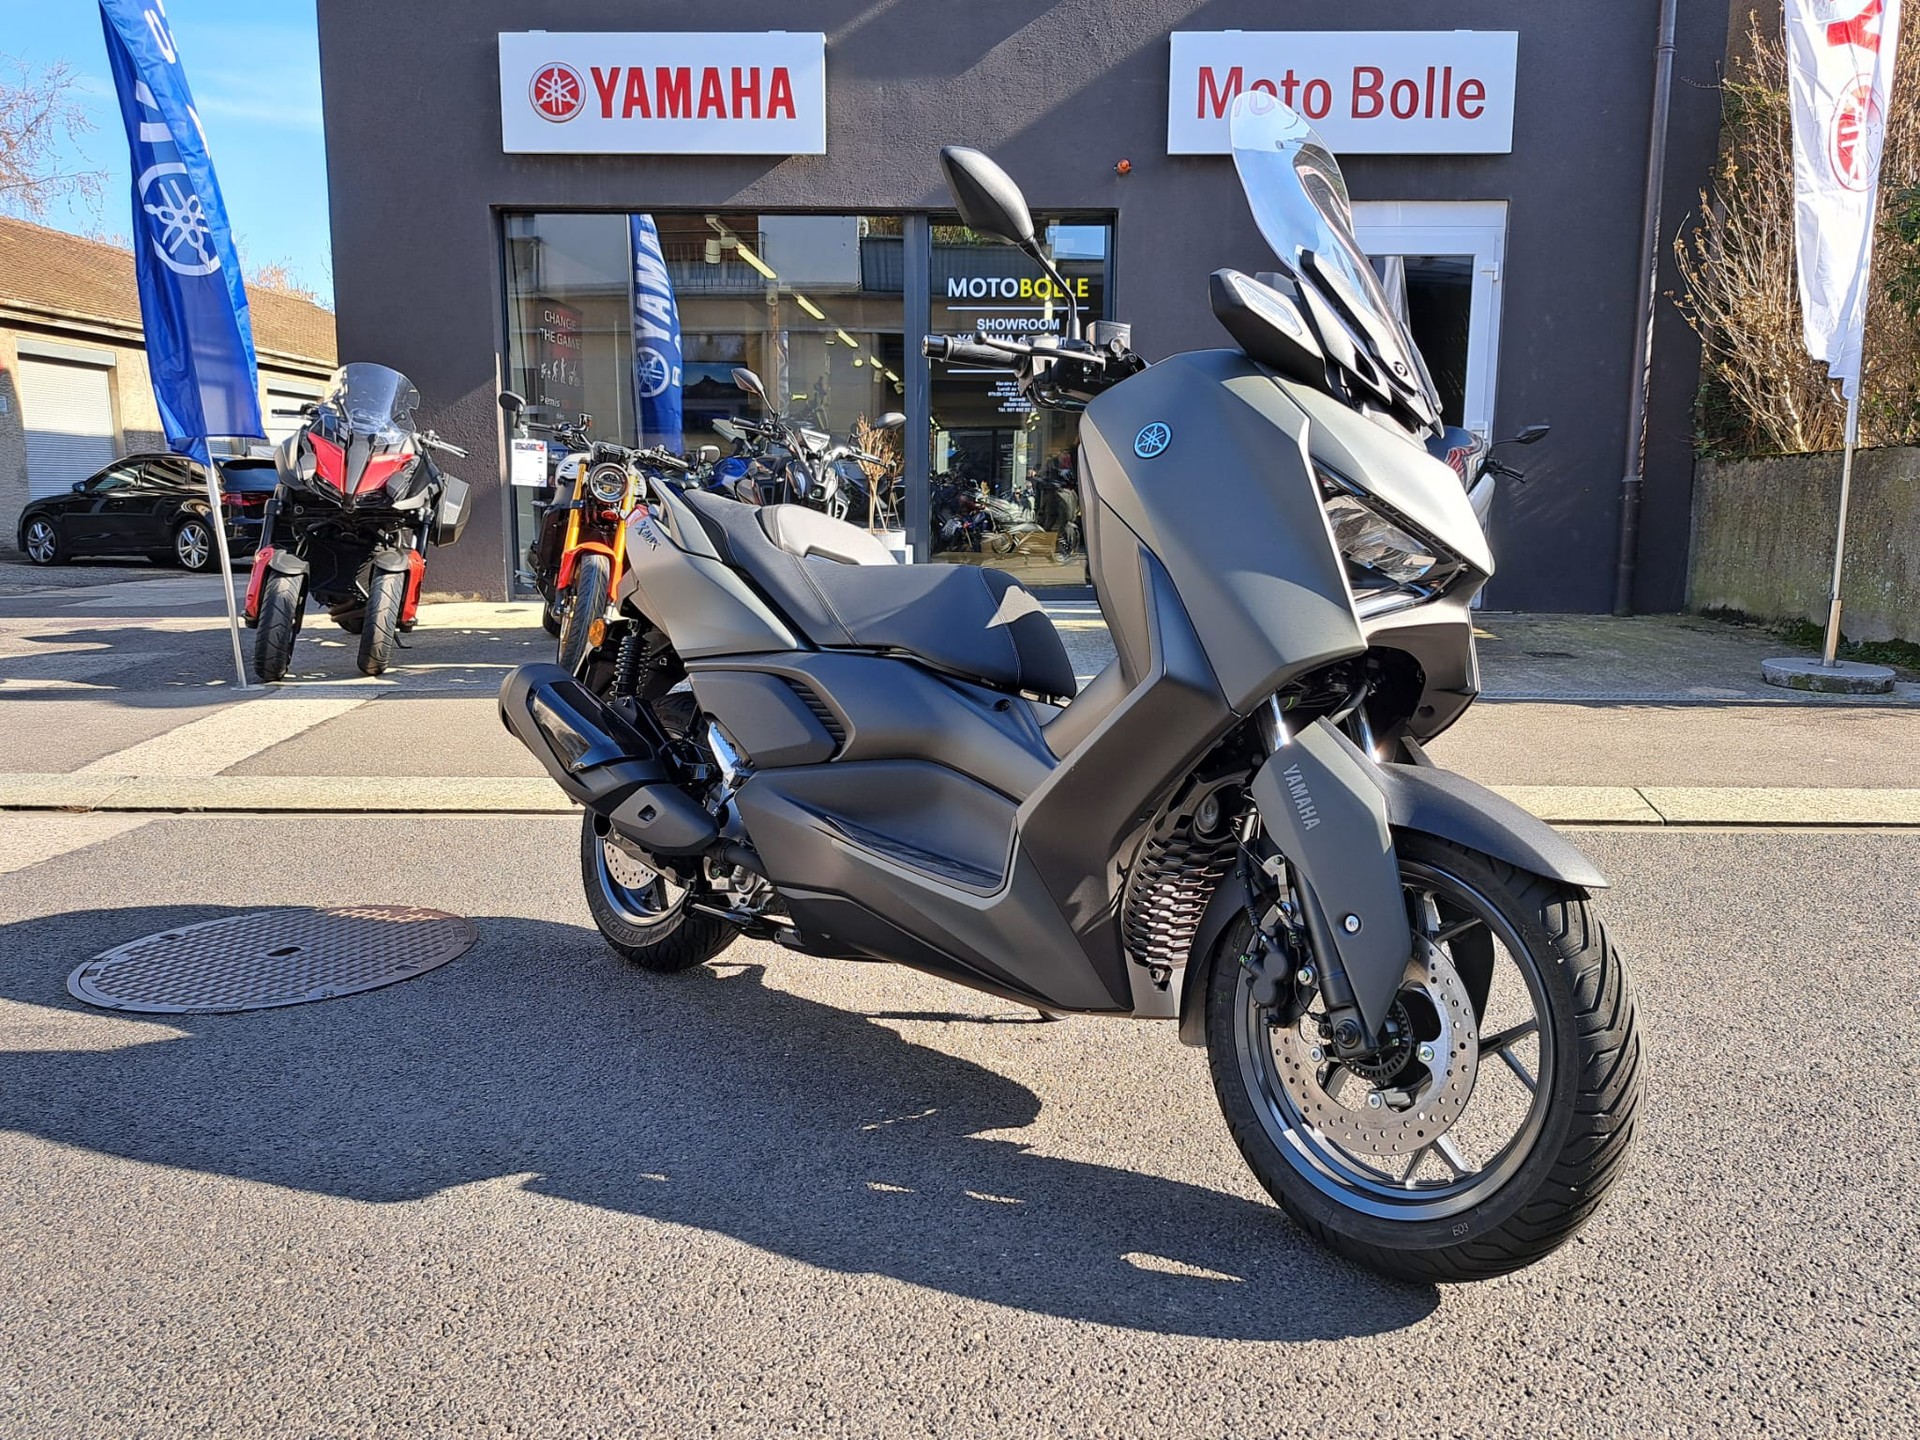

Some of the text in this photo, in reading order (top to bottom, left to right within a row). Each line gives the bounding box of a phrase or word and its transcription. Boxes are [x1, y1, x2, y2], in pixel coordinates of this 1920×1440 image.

[590, 66, 797, 119] YAMAHA
[1197, 66, 1486, 119] Moto Bolle
[635, 214, 673, 342] YAMA
[544, 310, 577, 331] CHANGE
[976, 318, 1060, 331] SHOWROOM
[540, 327, 582, 350] THE GAME
[957, 333, 1014, 344] YAHA
[1283, 763, 1321, 831] YAMAHA
[599, 908, 645, 942] MICHELIN
